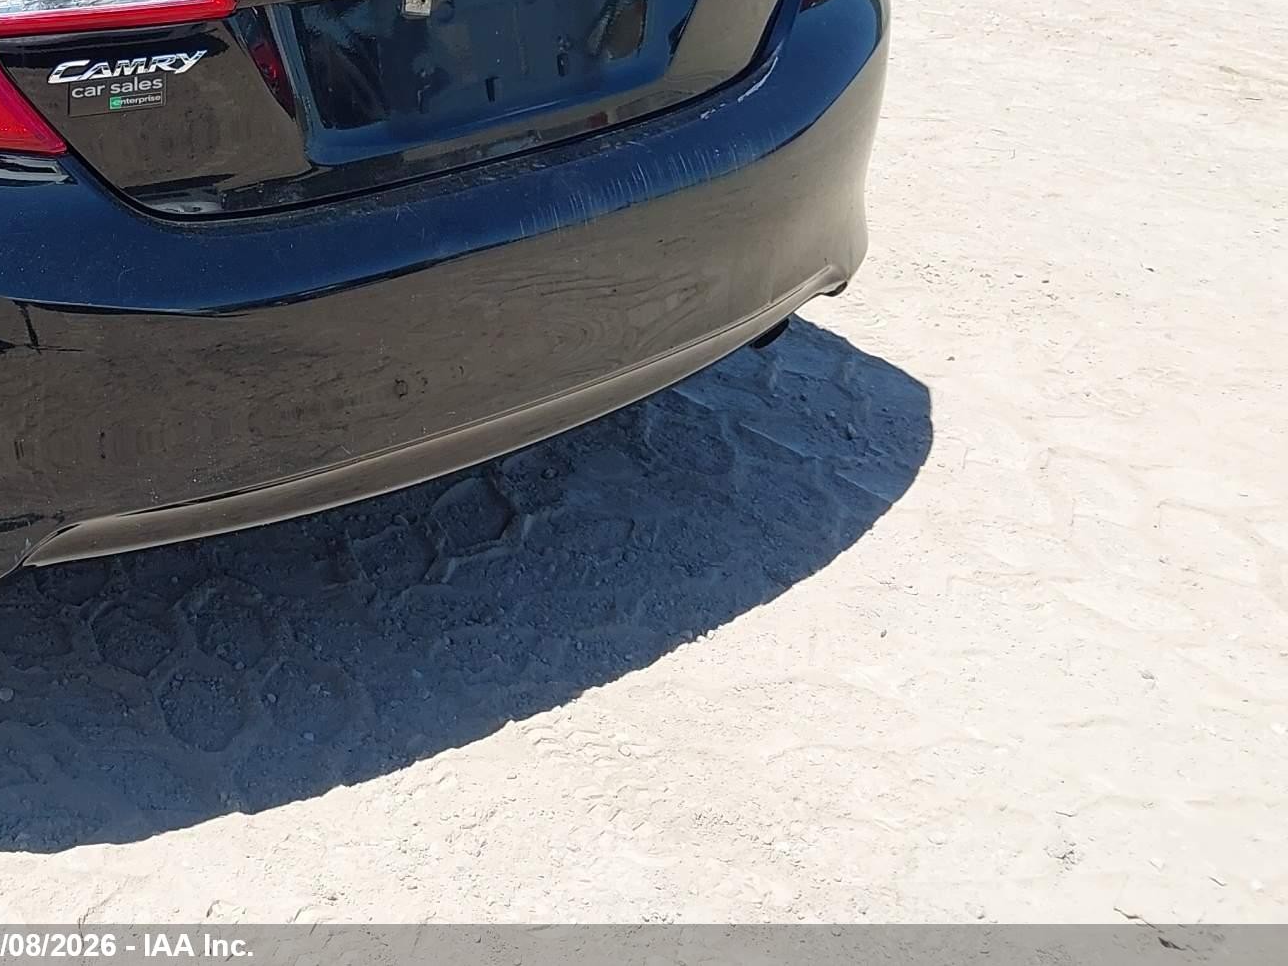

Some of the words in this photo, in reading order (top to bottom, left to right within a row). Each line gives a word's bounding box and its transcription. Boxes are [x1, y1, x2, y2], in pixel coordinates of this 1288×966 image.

[48, 50, 207, 84] CAMRY
[71, 85, 106, 99] car
[110, 77, 163, 95] sales
[112, 95, 162, 106] enterprise
